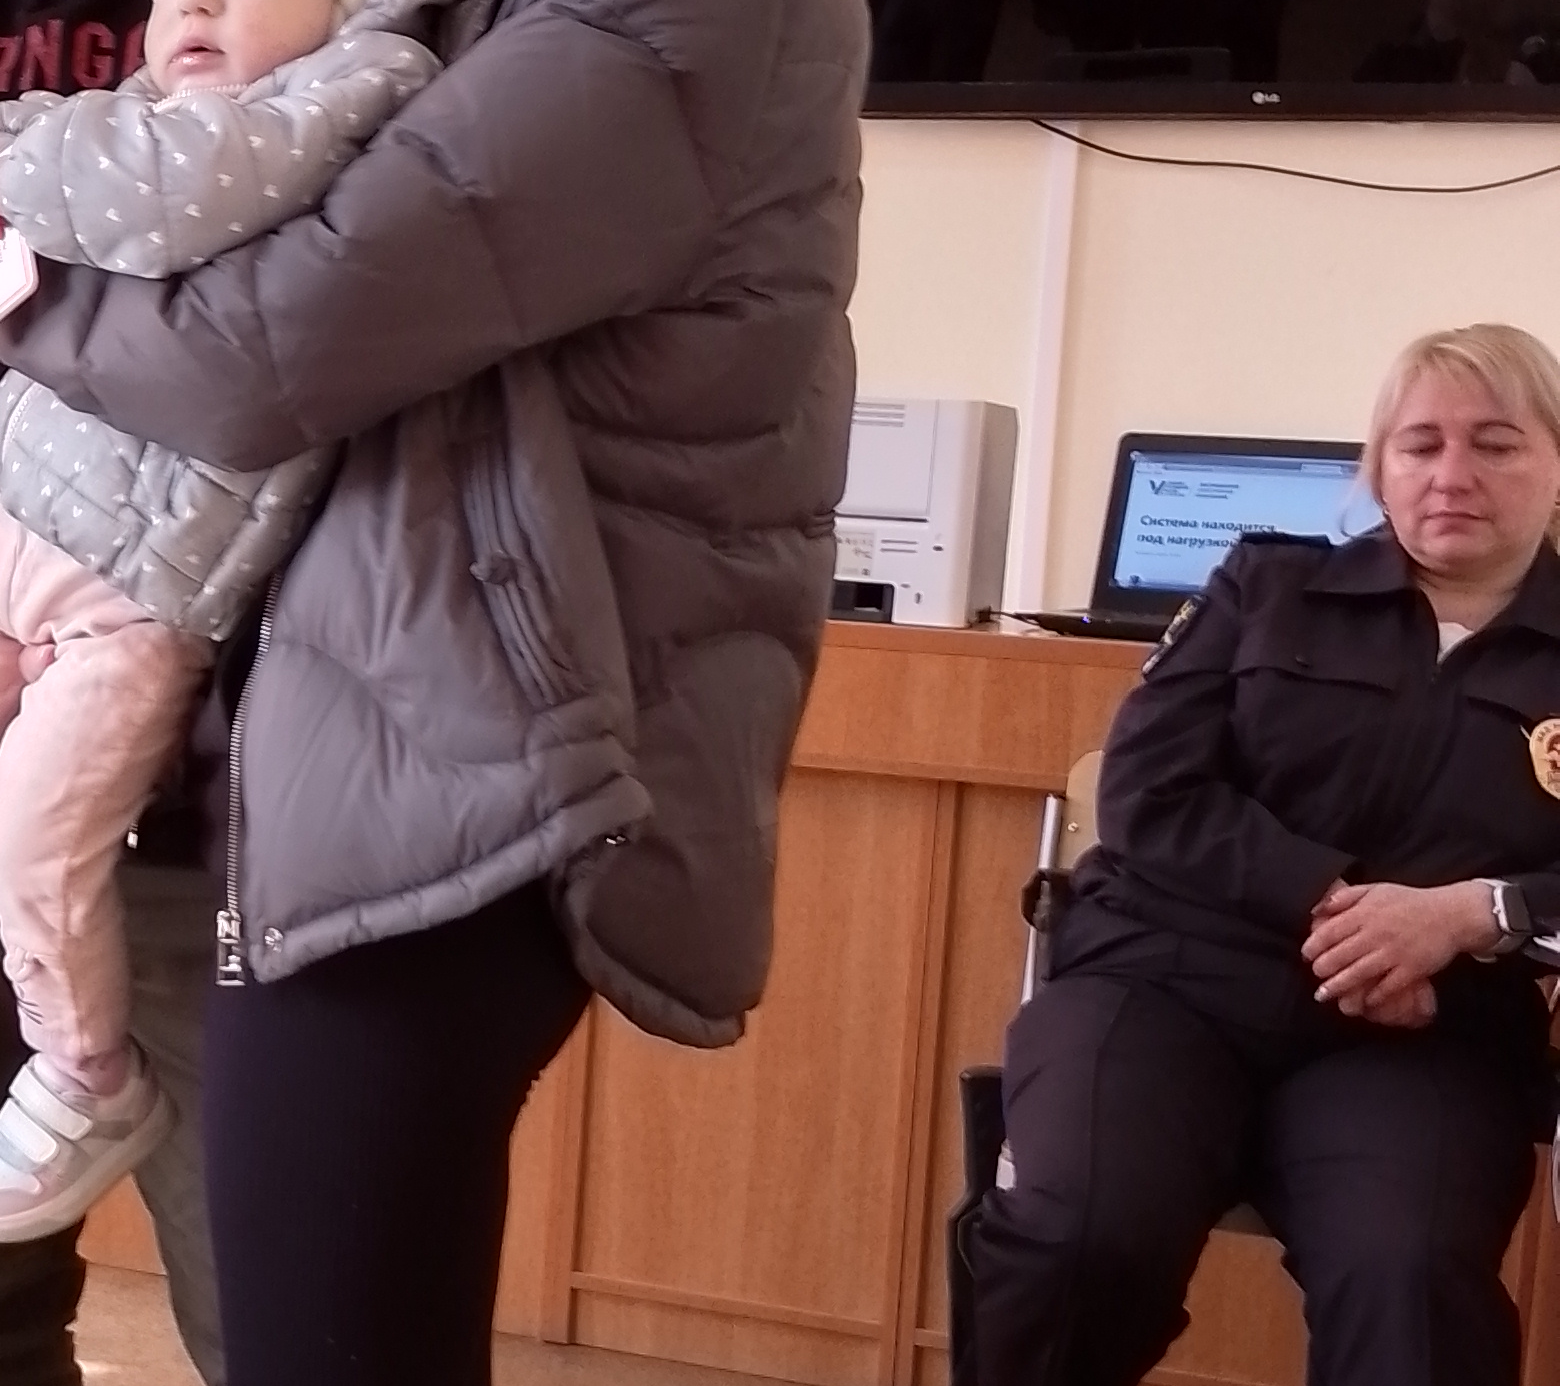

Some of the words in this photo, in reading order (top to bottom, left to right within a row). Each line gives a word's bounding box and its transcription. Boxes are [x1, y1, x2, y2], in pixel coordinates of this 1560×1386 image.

[1140, 514, 1198, 529] Система
[1200, 520, 1276, 533] находится
[1136, 533, 1164, 545] под
